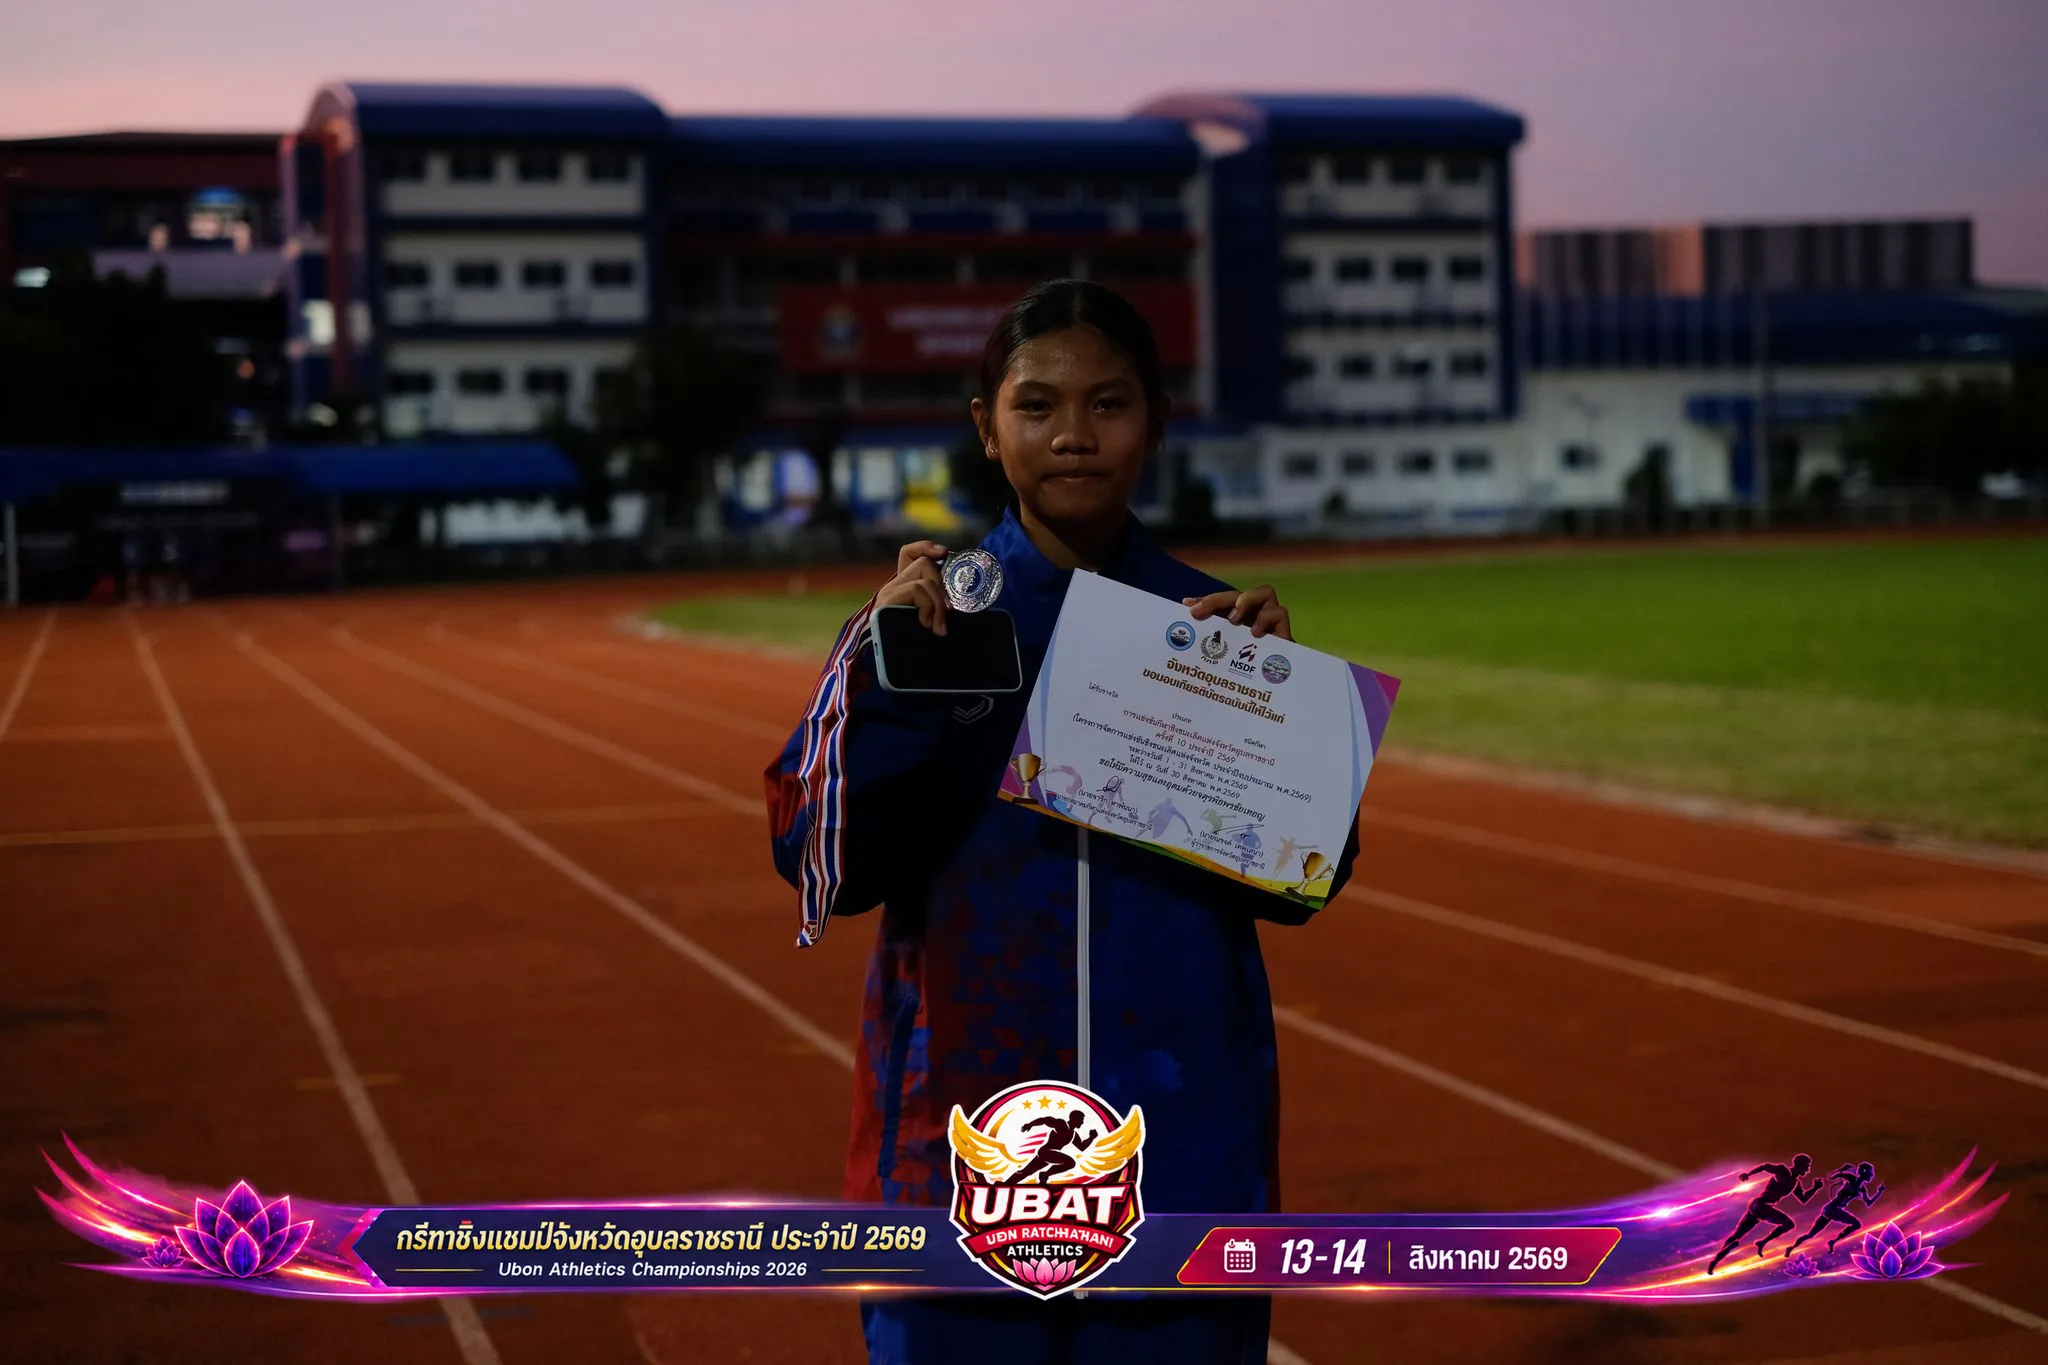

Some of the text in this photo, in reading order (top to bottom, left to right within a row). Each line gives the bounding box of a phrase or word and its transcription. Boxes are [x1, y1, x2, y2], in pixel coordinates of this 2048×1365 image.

[1166, 658, 1272, 703] จังหวัดอุบลราชธานี
[1229, 659, 1255, 673] NSDF
[1142, 668, 1285, 723] ขอมอบเกียรติบัตรฉบับนี้ให้ไว้แก่
[1177, 738, 1186, 746] 10
[1188, 743, 1214, 757] ประจำปี
[1216, 752, 1236, 764] 2569
[1170, 770, 1180, 778] 30
[1209, 784, 1240, 799] พ.ศ.2569
[1178, 761, 1187, 769] 31
[1217, 776, 1248, 790] พ.ศ.2569
